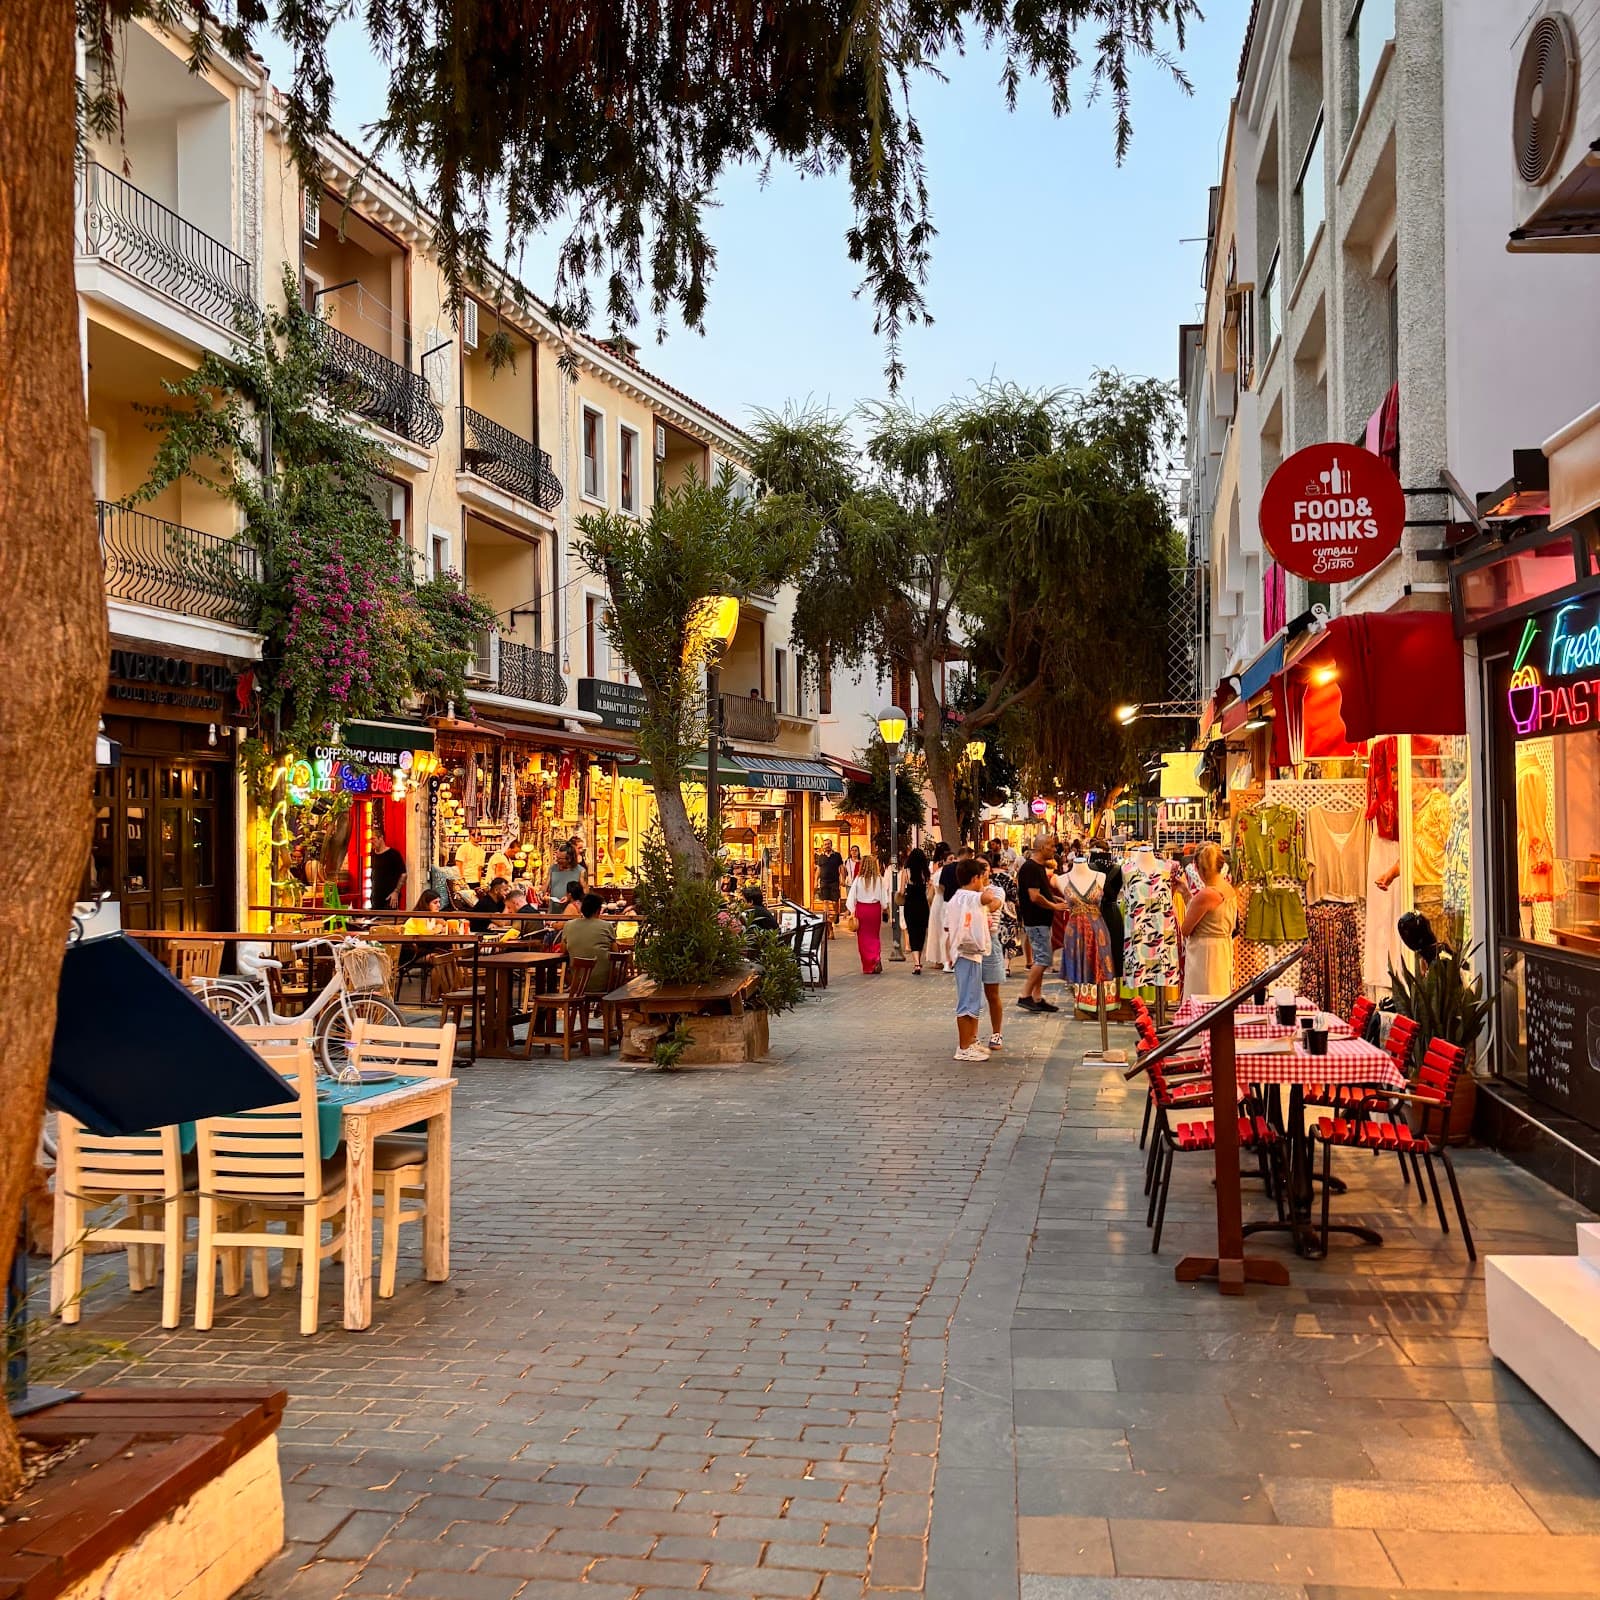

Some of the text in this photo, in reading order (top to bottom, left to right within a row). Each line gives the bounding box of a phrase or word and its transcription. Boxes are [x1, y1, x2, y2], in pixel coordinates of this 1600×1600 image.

[1294, 497, 1373, 521] FOOD&
[1291, 519, 1379, 542] DRINKS
[368, 751, 398, 765] GALERIE
[763, 774, 829, 791] SILVER HARMONI
[1168, 803, 1202, 820] LOFT
